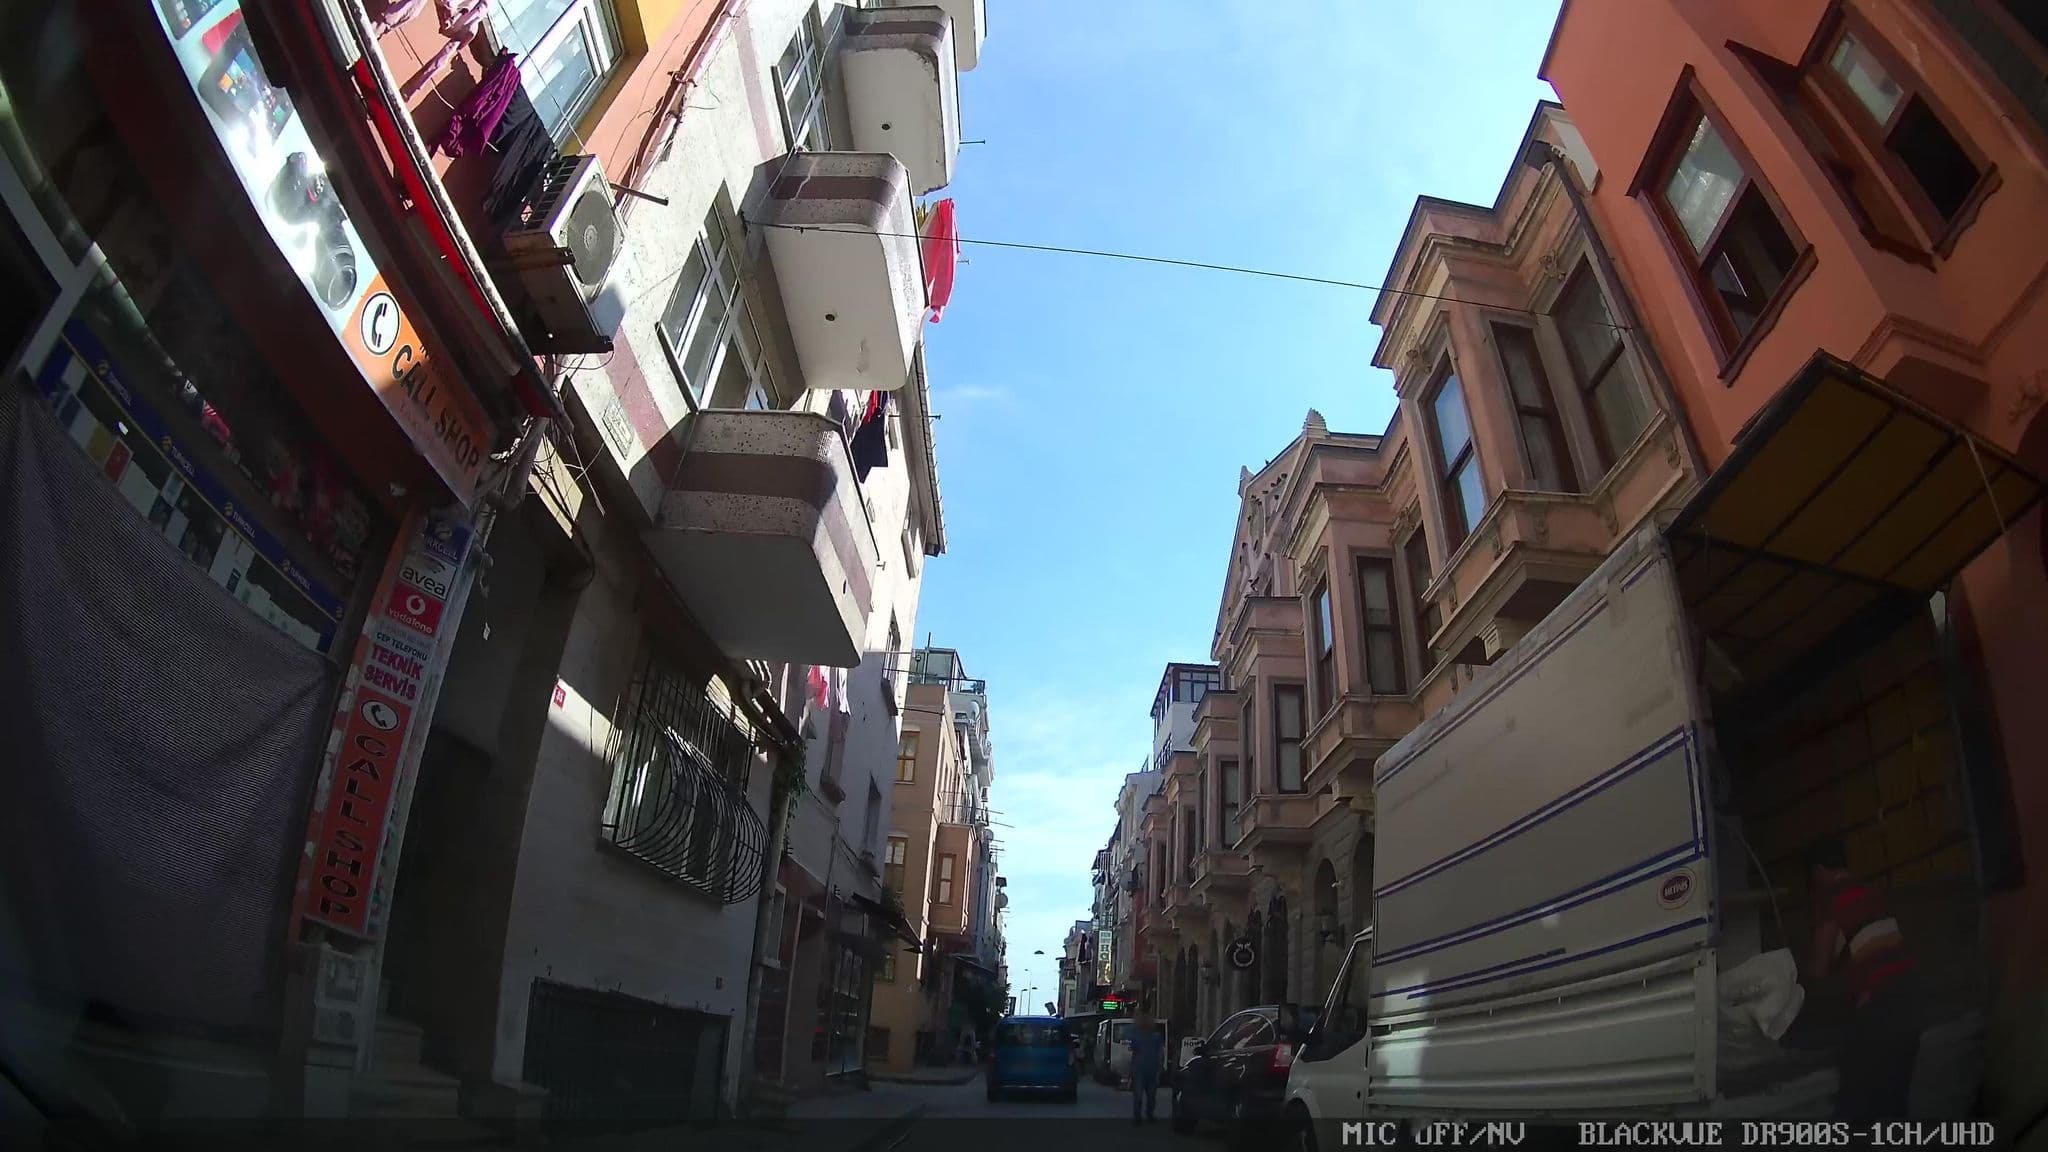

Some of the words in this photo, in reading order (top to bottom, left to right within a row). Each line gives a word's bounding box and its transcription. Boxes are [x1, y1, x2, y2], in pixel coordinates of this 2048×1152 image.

[392, 344, 437, 421] CALL
[434, 407, 480, 474] SHOP
[402, 566, 446, 597] avea
[388, 607, 433, 635] vodafone
[372, 643, 424, 681] TEKNİK
[391, 638, 428, 662] TELEFONU
[364, 664, 417, 700] SERVİS
[339, 733, 388, 826] CALL
[319, 828, 364, 915] SHOP
